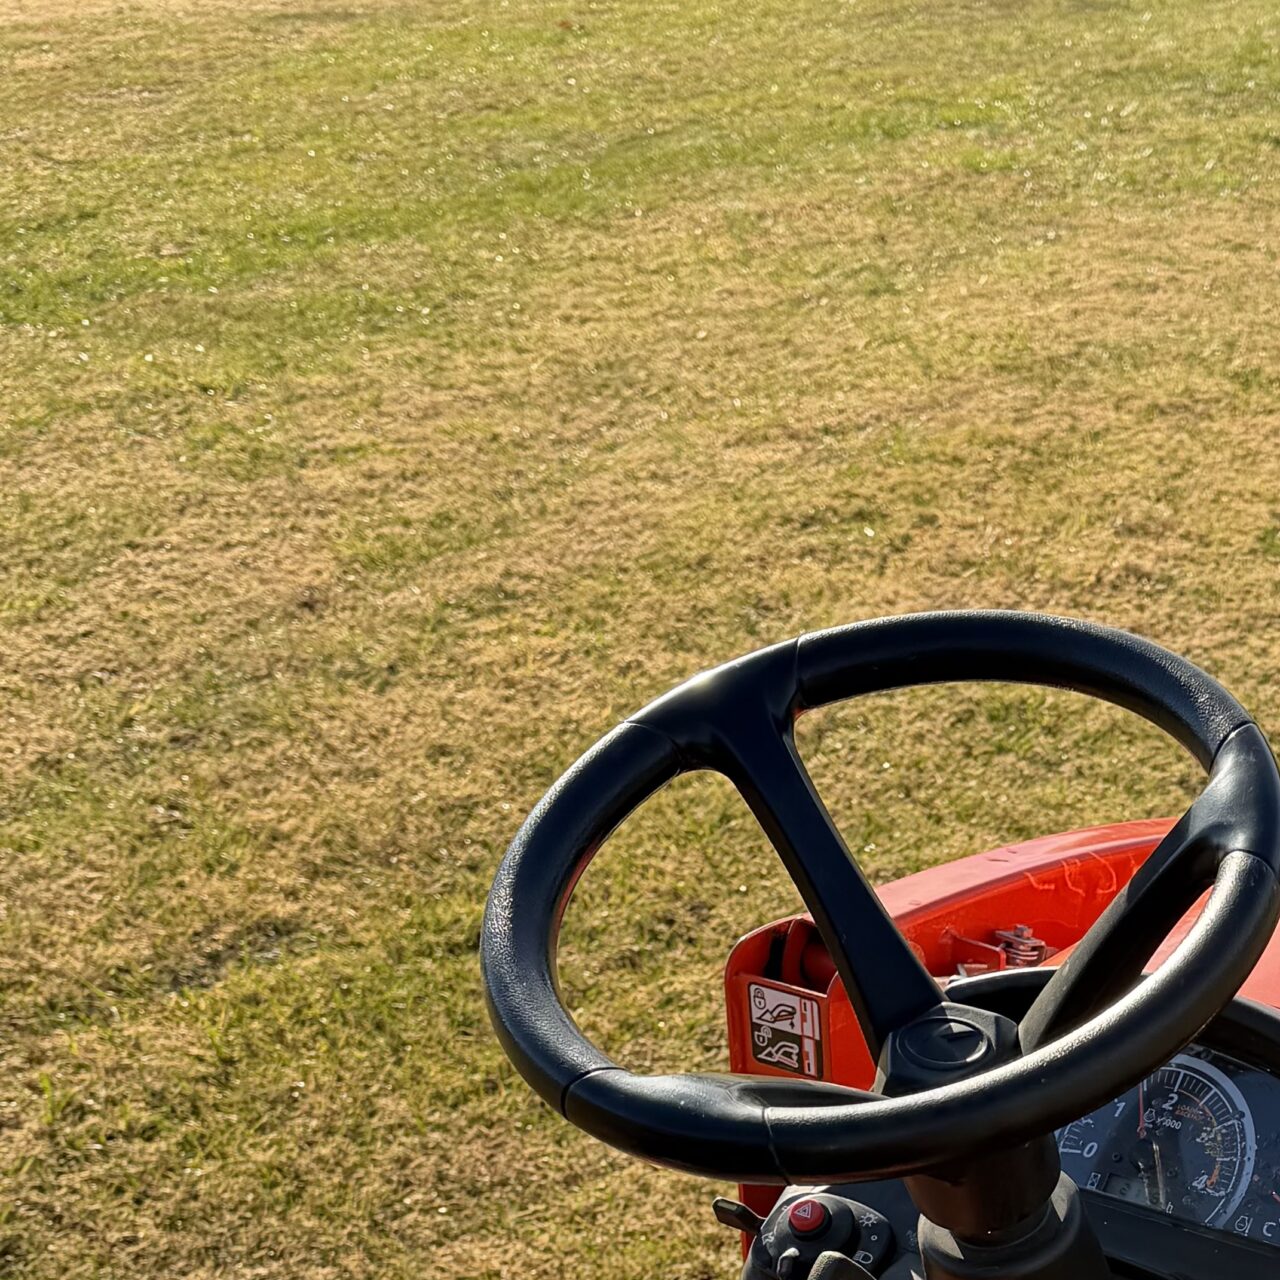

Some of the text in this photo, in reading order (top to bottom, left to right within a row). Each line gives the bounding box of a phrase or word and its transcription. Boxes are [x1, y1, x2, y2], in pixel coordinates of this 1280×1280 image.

[1114, 1101, 1126, 1117] 1
[1162, 1093, 1179, 1110] 2
[1083, 1142, 1098, 1157] 0
[1263, 1221, 1276, 1237] C
